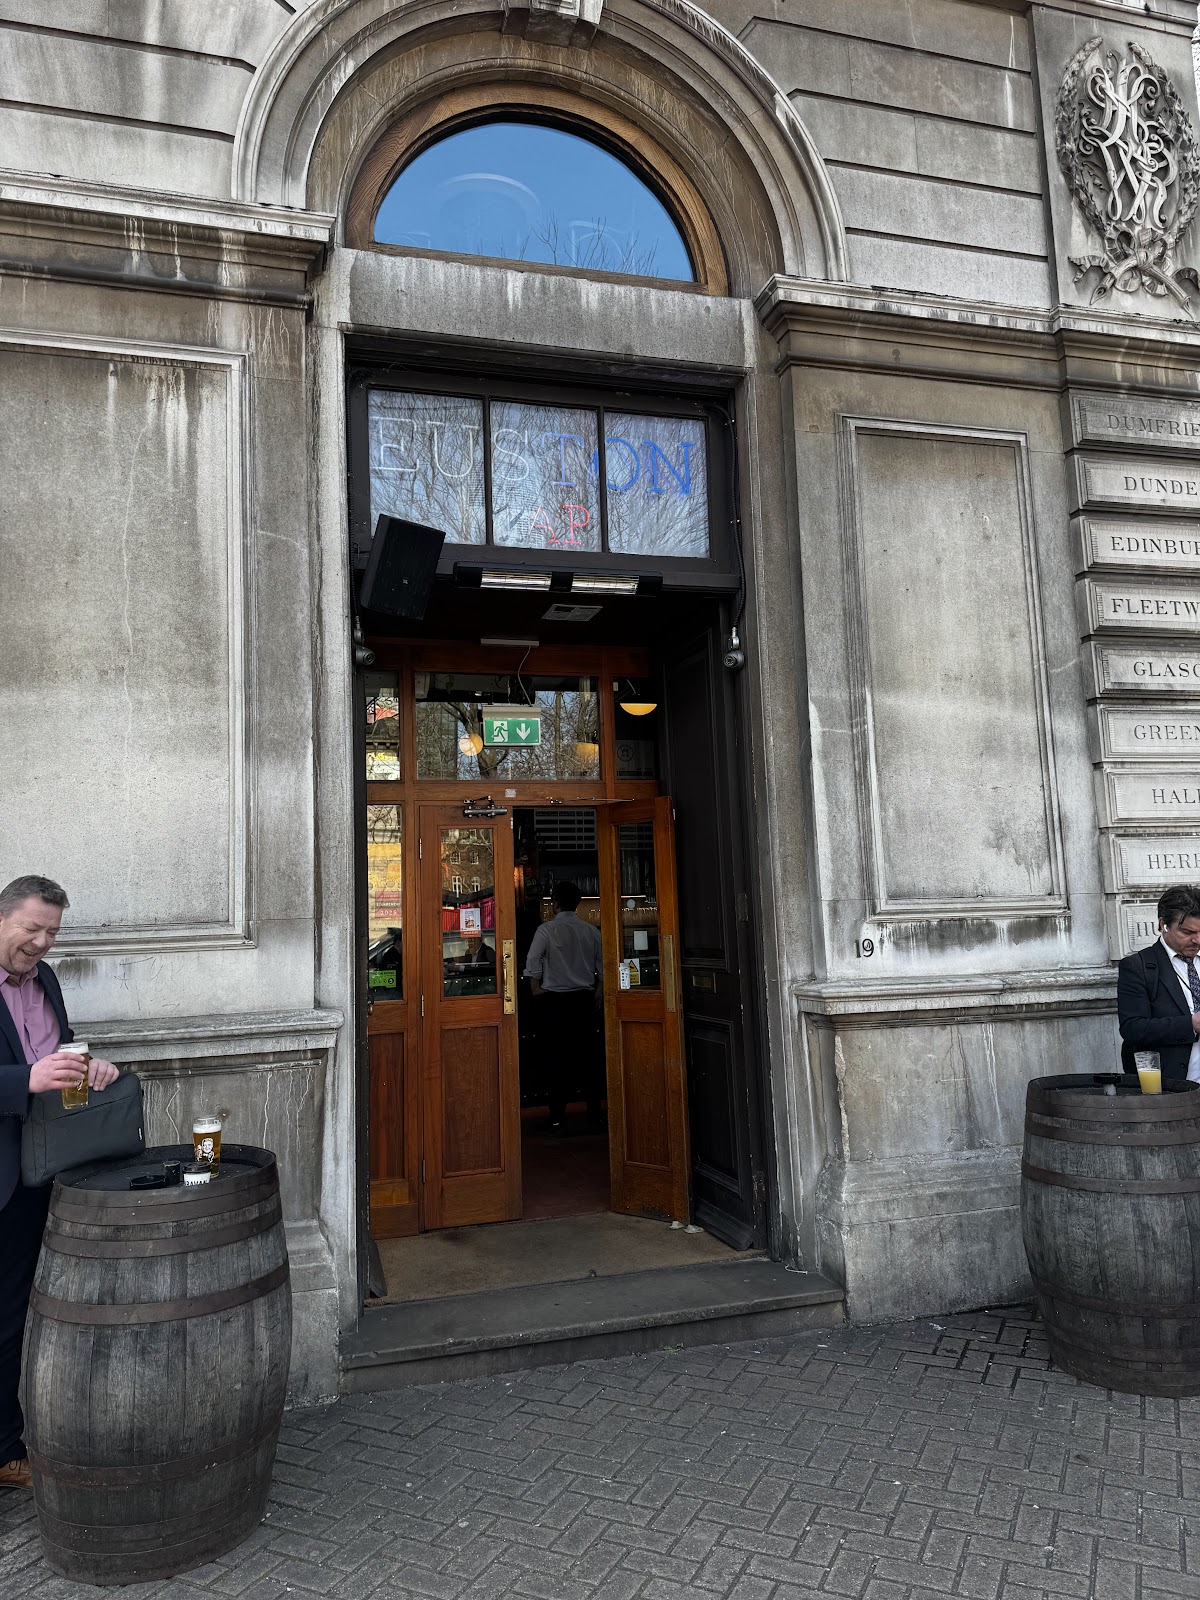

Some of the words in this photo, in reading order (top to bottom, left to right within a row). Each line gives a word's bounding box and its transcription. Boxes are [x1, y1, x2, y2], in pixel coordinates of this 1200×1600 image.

[369, 416, 696, 496] EUSTON
[1112, 598, 1200, 616] FLEETW
[855, 939, 874, 958] 19
